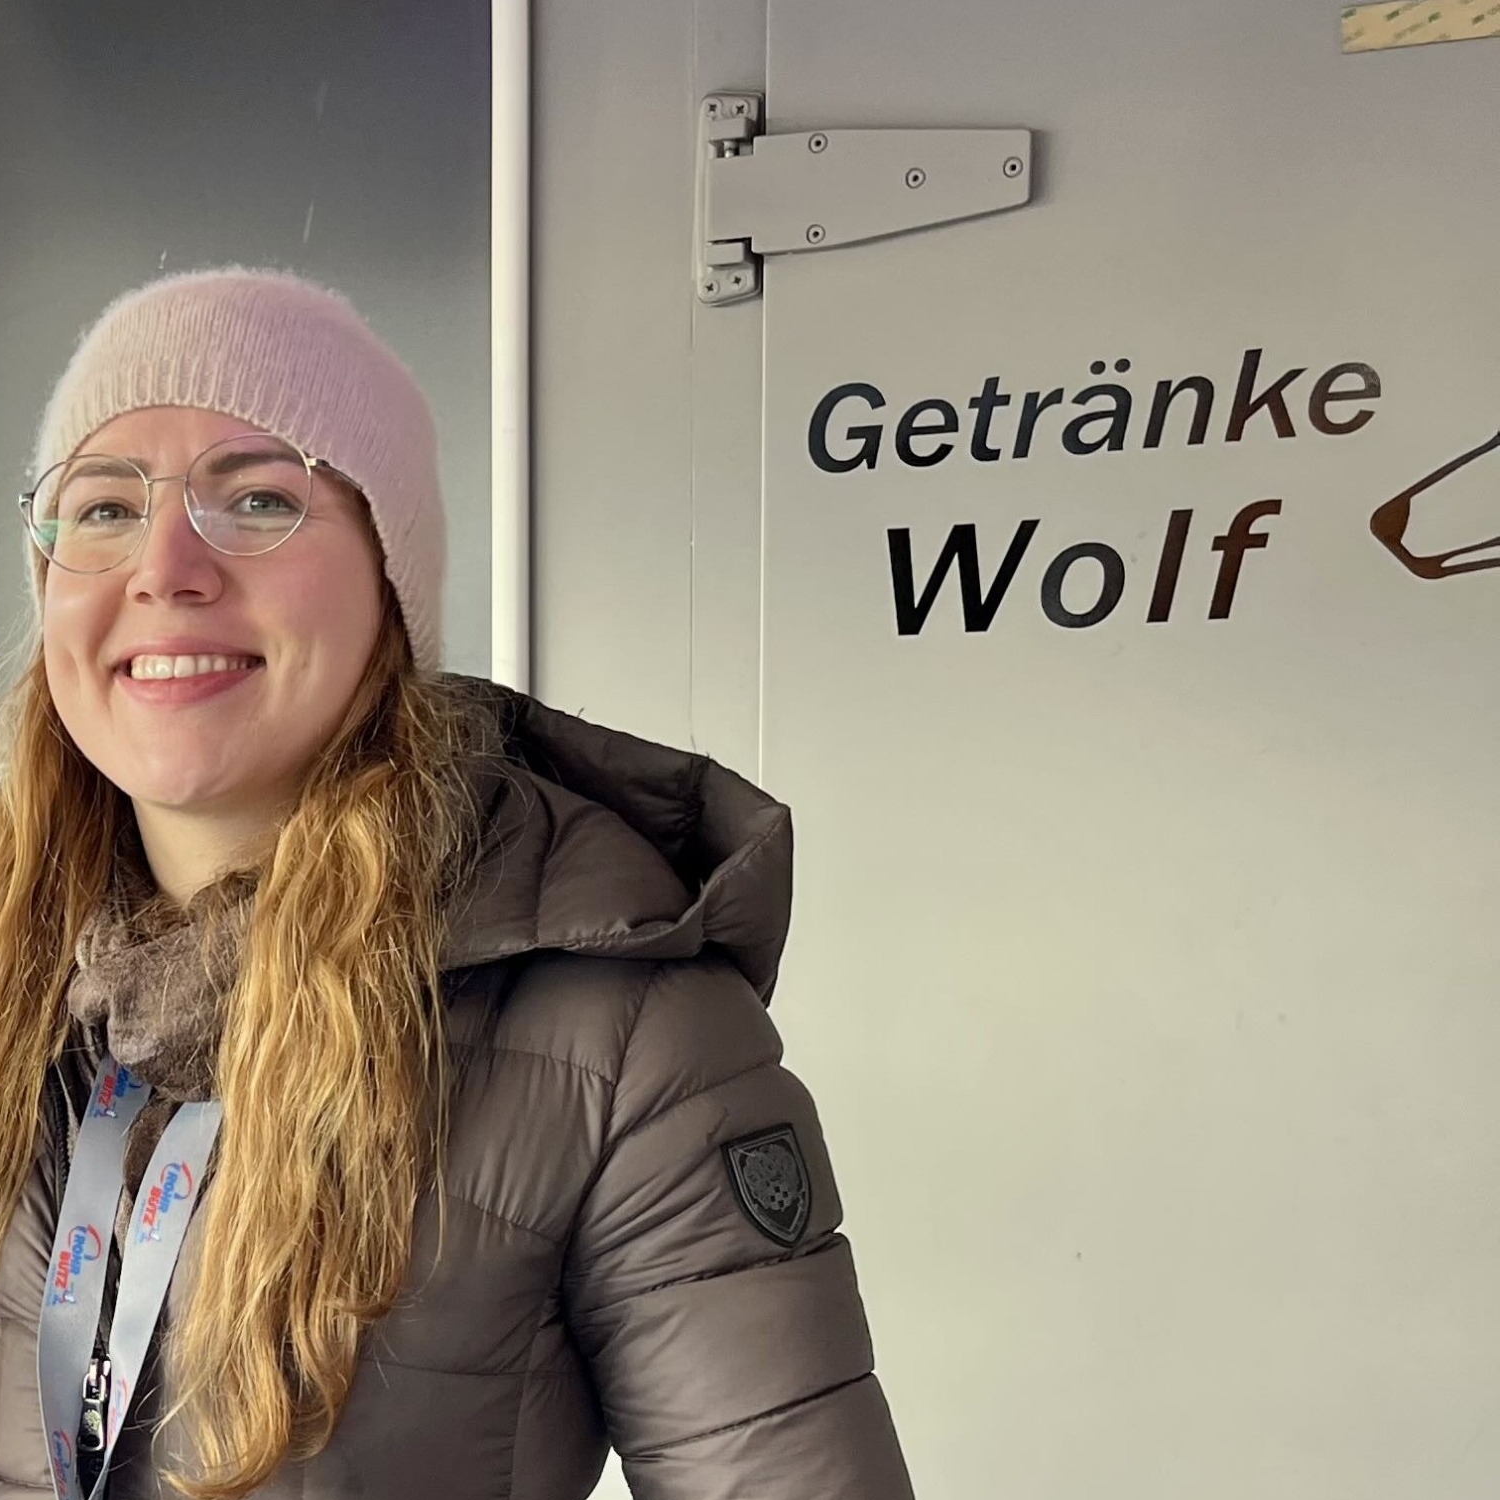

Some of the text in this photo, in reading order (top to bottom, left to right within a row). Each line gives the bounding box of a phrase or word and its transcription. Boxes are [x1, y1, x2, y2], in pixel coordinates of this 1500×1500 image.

[807, 347, 1381, 474] Getränke
[886, 498, 1282, 637] Wolf
[143, 1185, 163, 1227] BUTZ
[159, 1171, 179, 1213] ROHR
[55, 1250, 71, 1289] BUTZ
[70, 1234, 86, 1275] ROHR
